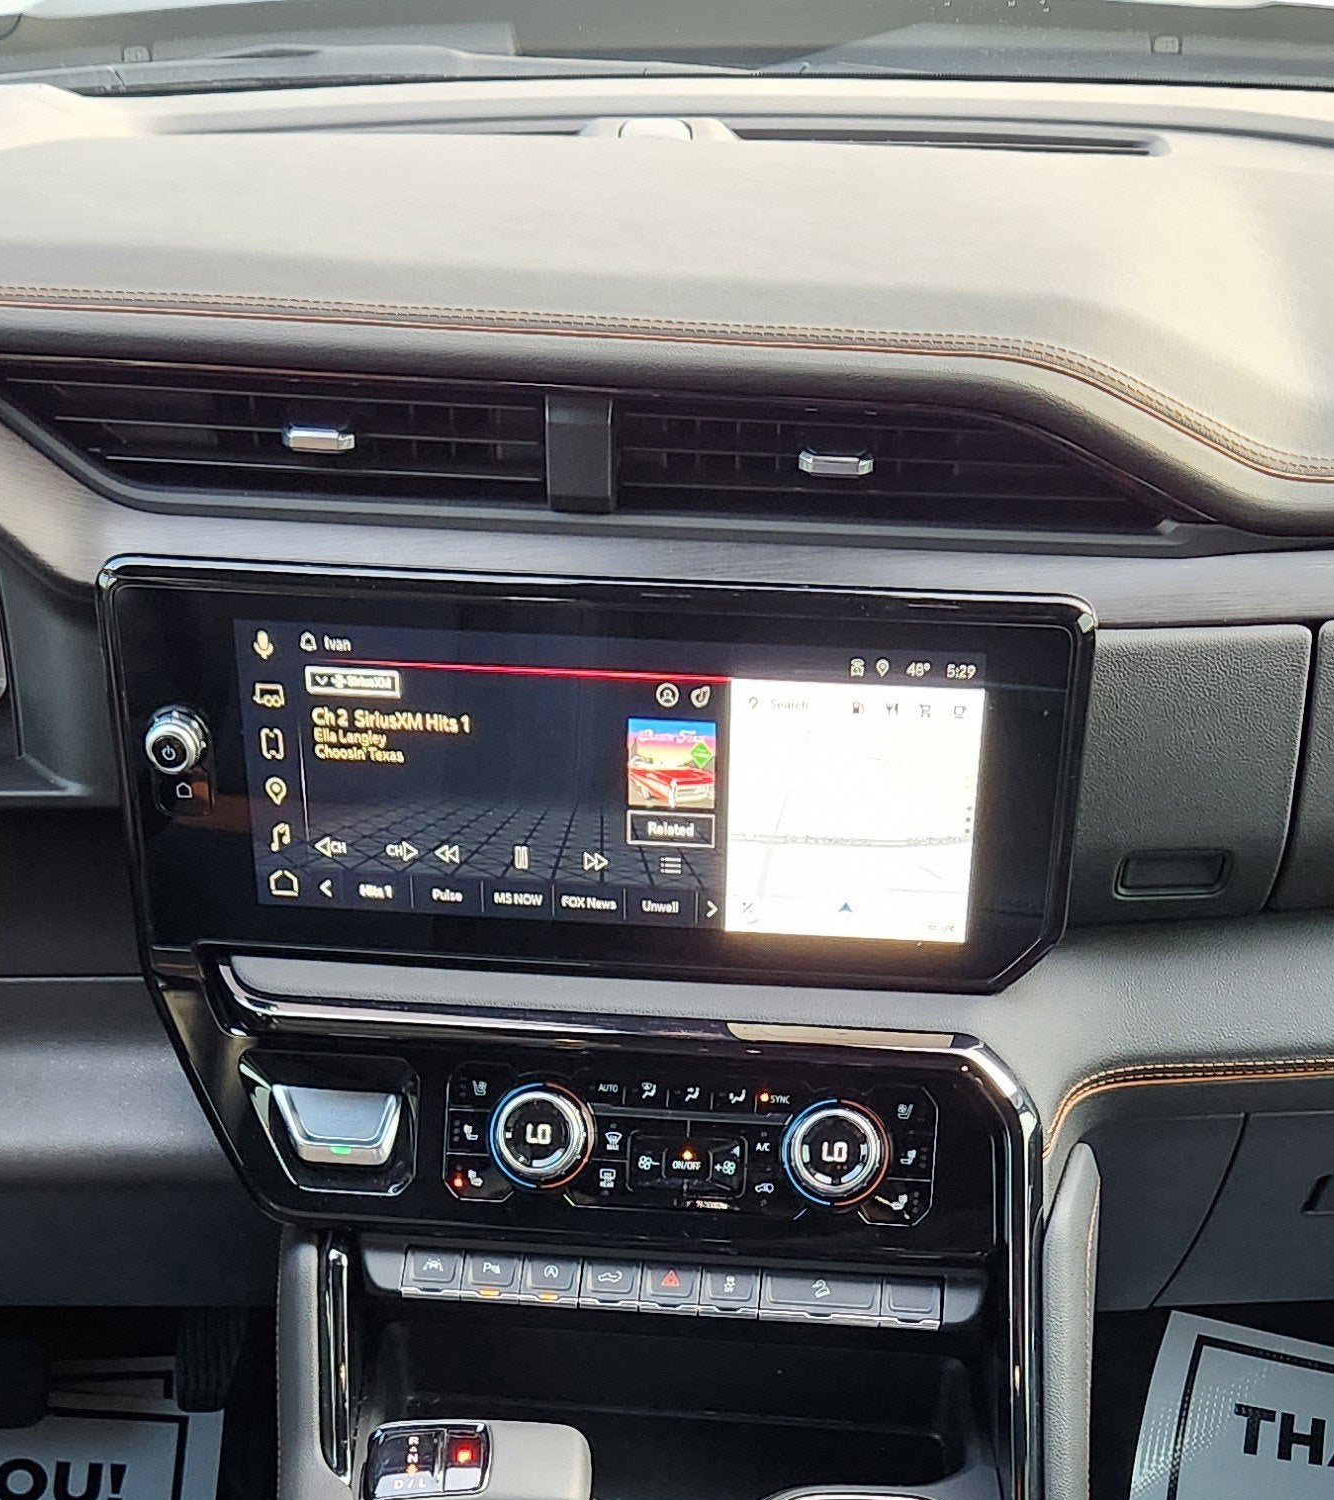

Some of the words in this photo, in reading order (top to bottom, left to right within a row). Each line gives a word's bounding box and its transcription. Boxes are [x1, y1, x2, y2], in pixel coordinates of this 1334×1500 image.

[324, 635, 352, 652] Ivan
[946, 663, 977, 681] 5:29
[770, 699, 809, 711] Search
[312, 707, 336, 726] Ch
[337, 708, 349, 727] 2
[354, 709, 422, 732] SiriusXM
[425, 713, 459, 734] Hits
[460, 714, 470, 734] 1
[313, 728, 337, 744] Ella
[338, 729, 387, 748] Langley
[368, 747, 405, 763] Texas
[647, 821, 695, 838] Related
[332, 842, 347, 854] CH
[386, 844, 404, 857] CH
[385, 885, 393, 899] 1
[432, 888, 462, 903] Pulse
[494, 892, 511, 905] MS
[513, 893, 543, 907] NOW
[561, 895, 585, 909] FOX
[586, 896, 617, 911] News
[642, 900, 679, 914] Unwell
[598, 1083, 619, 1093] AUTO
[770, 1094, 790, 1105] SYNC
[756, 1142, 770, 1152] A/C
[822, 1141, 848, 1162] LO
[672, 1161, 701, 1170] ON/OFF
[408, 1436, 419, 1445] R
[407, 1453, 418, 1463] N
